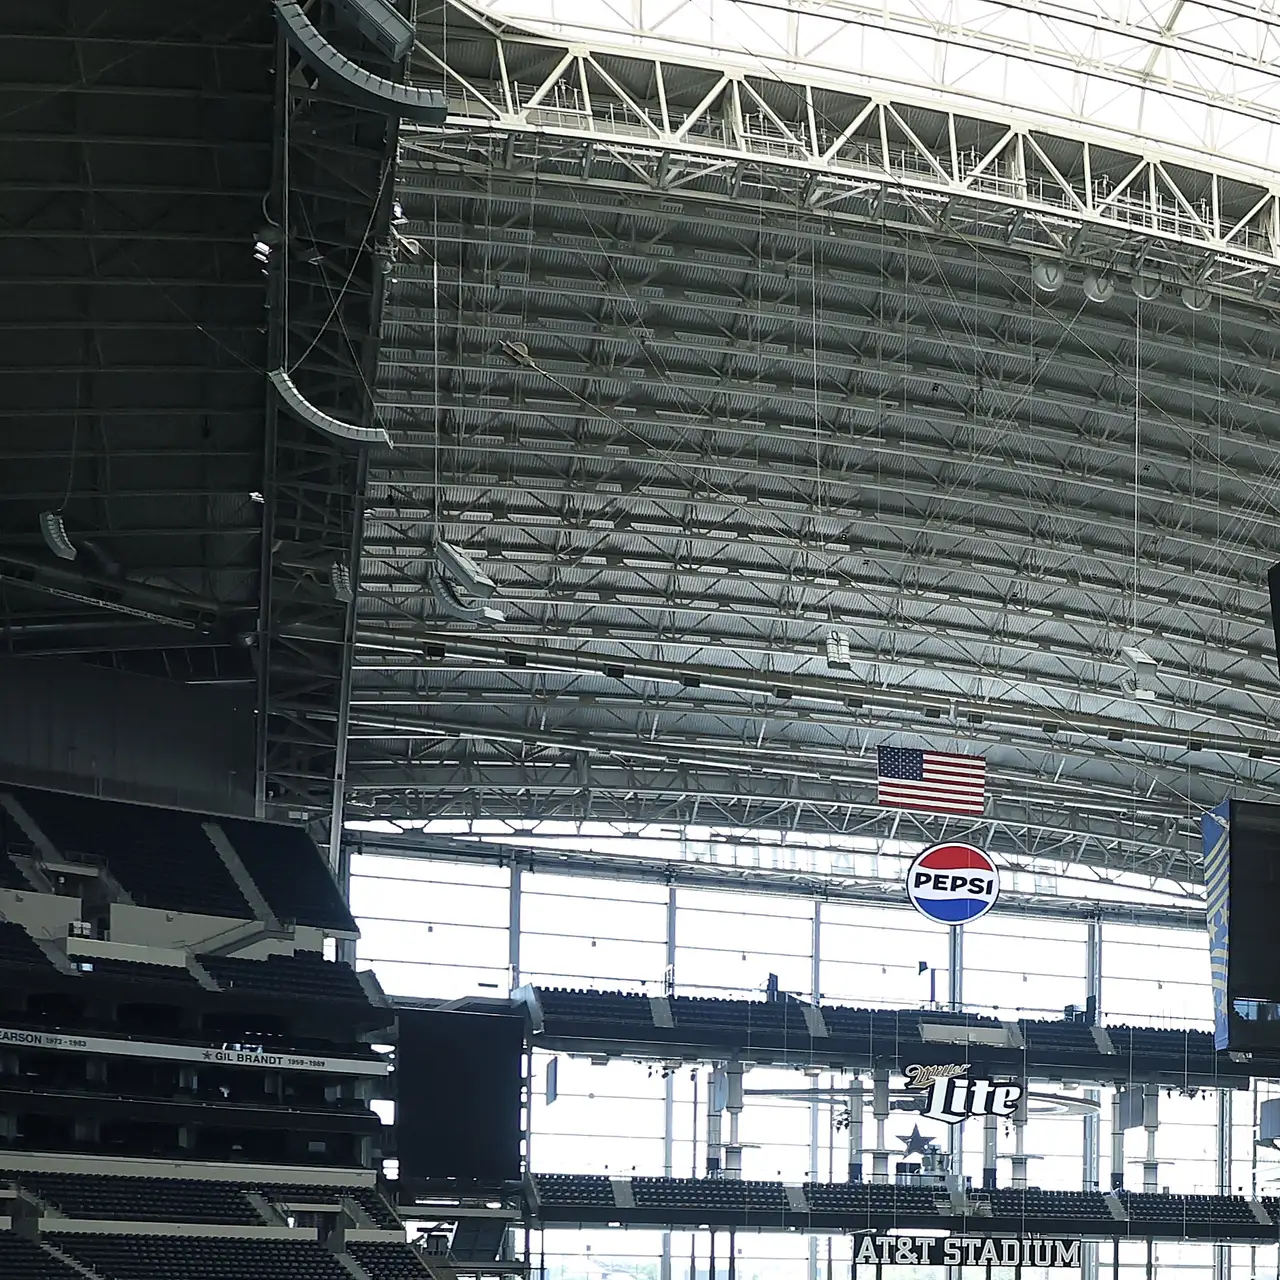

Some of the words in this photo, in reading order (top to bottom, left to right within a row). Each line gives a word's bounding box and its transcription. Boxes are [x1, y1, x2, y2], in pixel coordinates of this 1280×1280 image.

[914, 872, 994, 896] PEPSI
[215, 1051, 233, 1062] GIL
[236, 1053, 284, 1065] BRANDT
[905, 1063, 972, 1088] Miller
[923, 1076, 1022, 1124] Lite
[855, 1236, 936, 1265] AT&T
[943, 1237, 1082, 1267] STADIUM
